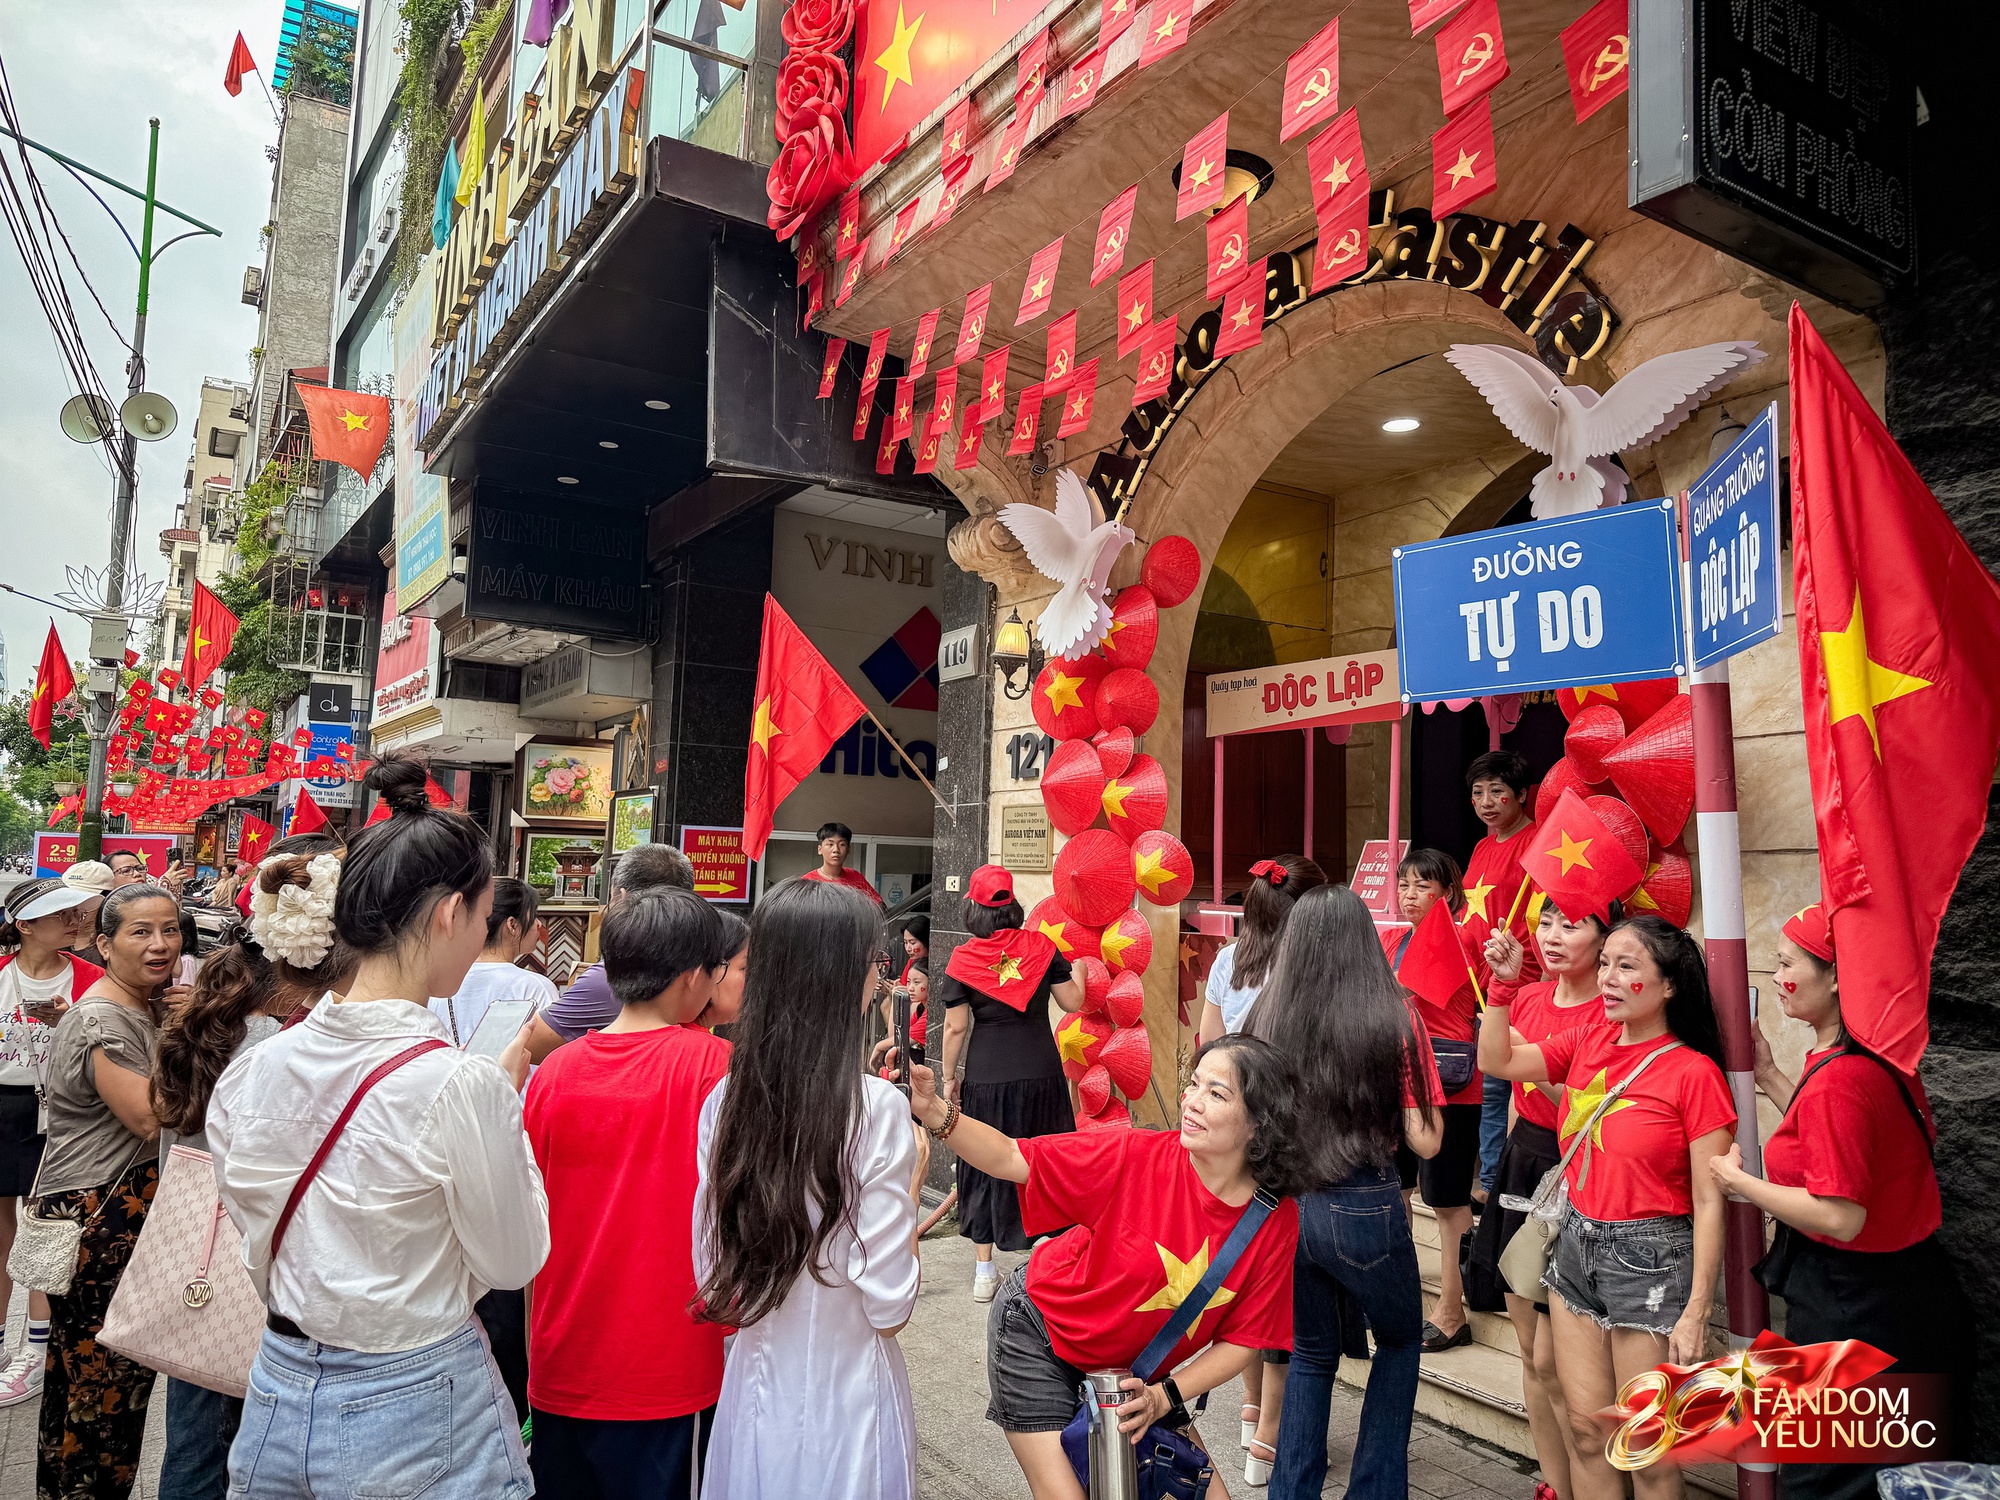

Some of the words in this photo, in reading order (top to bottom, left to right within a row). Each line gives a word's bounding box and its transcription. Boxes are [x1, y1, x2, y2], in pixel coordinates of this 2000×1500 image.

[556, 66, 636, 253] MAY
[1709, 68, 1786, 188] CÒN
[1796, 122, 1906, 249] PHÒNG
[1086, 250, 1308, 523] Auroa
[1693, 484, 1725, 538] QUẢNG
[1725, 445, 1765, 510] TRƯỜNG
[478, 506, 560, 550] VINH
[803, 533, 936, 589] VINH
[1471, 540, 1583, 583] ĐƯỜNG
[1700, 536, 1728, 643] ĐỘC
[1729, 510, 1761, 626] LẬP
[479, 562, 548, 601] MÁY
[554, 576, 636, 613] KHÂU
[1459, 590, 1520, 673] TỰ
[1537, 584, 1604, 654] DO
[549, 660, 557, 689] &
[557, 648, 584, 686] TRANH
[943, 637, 968, 668] 119
[1210, 678, 1230, 695] Quầy
[1230, 680, 1242, 692] tạp
[1243, 675, 1258, 689] hoá
[1261, 672, 1318, 718] ĐỘC
[1326, 660, 1384, 707] LẬP
[49, 843, 77, 857] 2-9
[697, 833, 716, 846] MÁY
[717, 834, 739, 847] KHÂU
[1004, 829, 1023, 838] AURORA
[1023, 827, 1034, 841] VIỆT
[1034, 829, 1046, 838] NAM
[686, 848, 718, 864] CHUYỂN
[718, 849, 746, 865] XUỐNG
[1375, 861, 1389, 875] TẶ
[1363, 875, 1385, 886] KHÔNG
[30, 1030, 51, 1044] do
